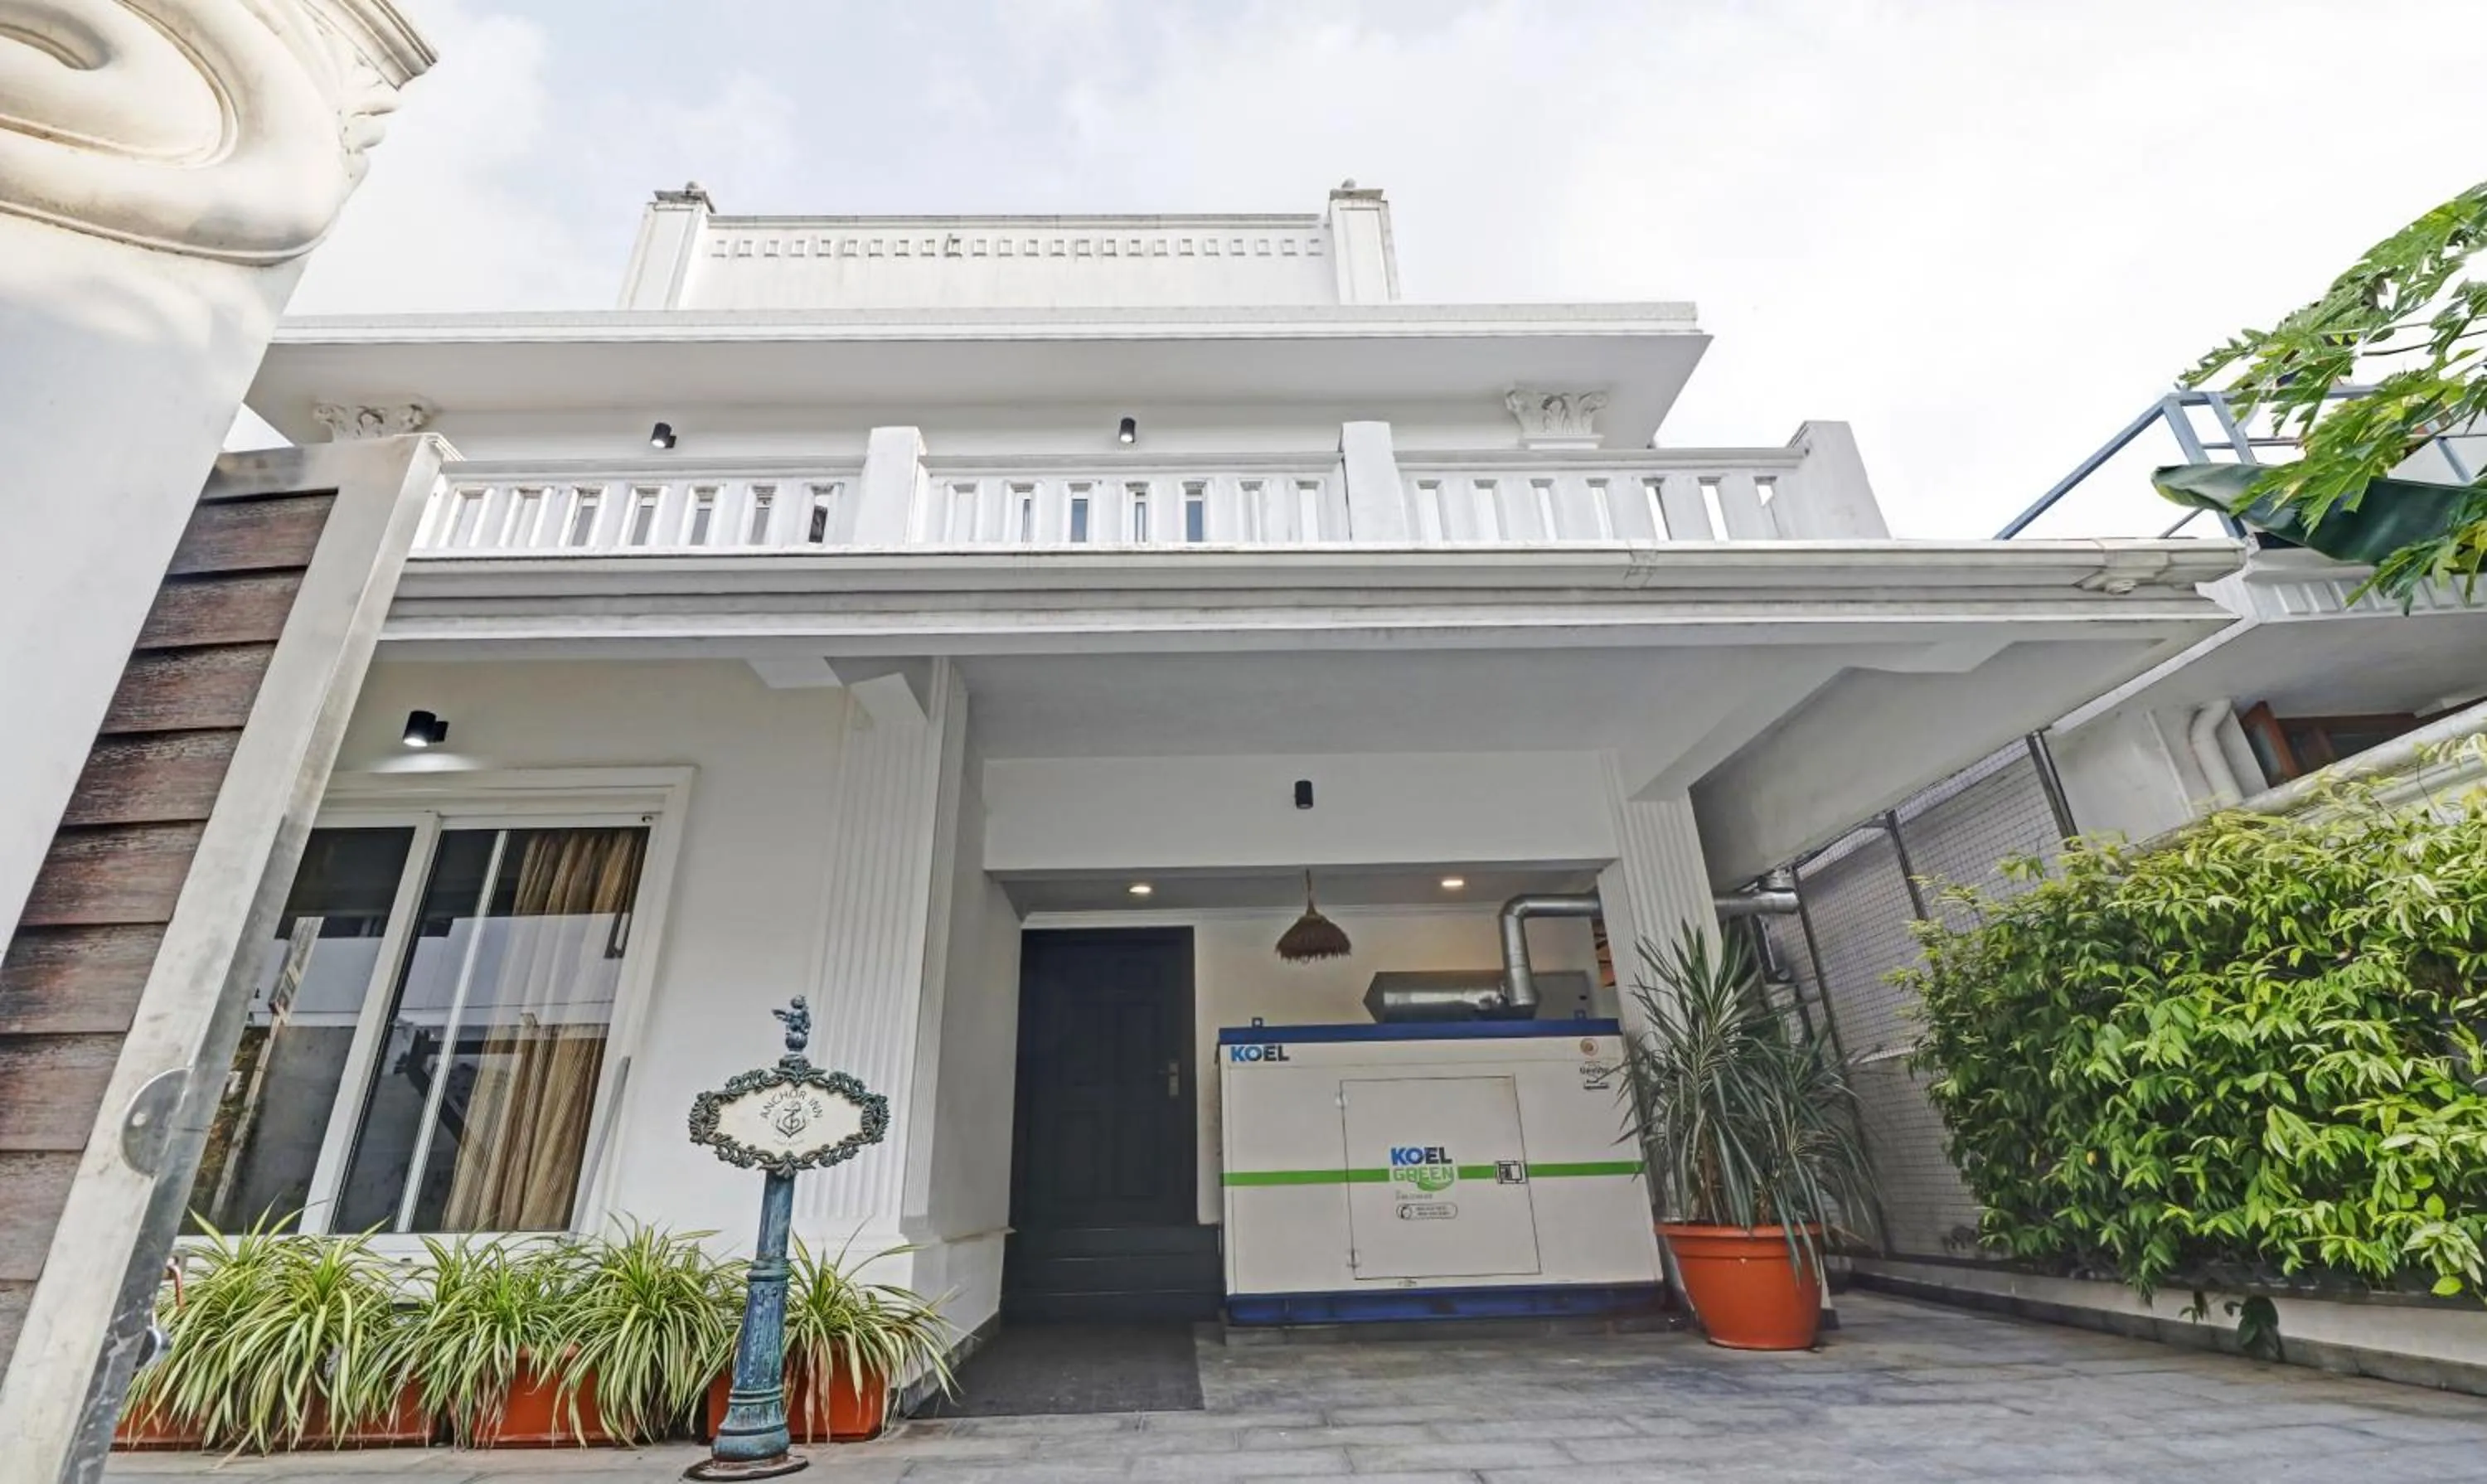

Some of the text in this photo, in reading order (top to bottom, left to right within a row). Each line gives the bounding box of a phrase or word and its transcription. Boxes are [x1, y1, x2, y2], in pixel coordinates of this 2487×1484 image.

[1230, 1045, 1290, 1062] KOEL
[759, 1089, 823, 1119] ANCHOR INN
[1391, 1147, 1453, 1166] KOEL
[1393, 1166, 1455, 1182] GREEN
